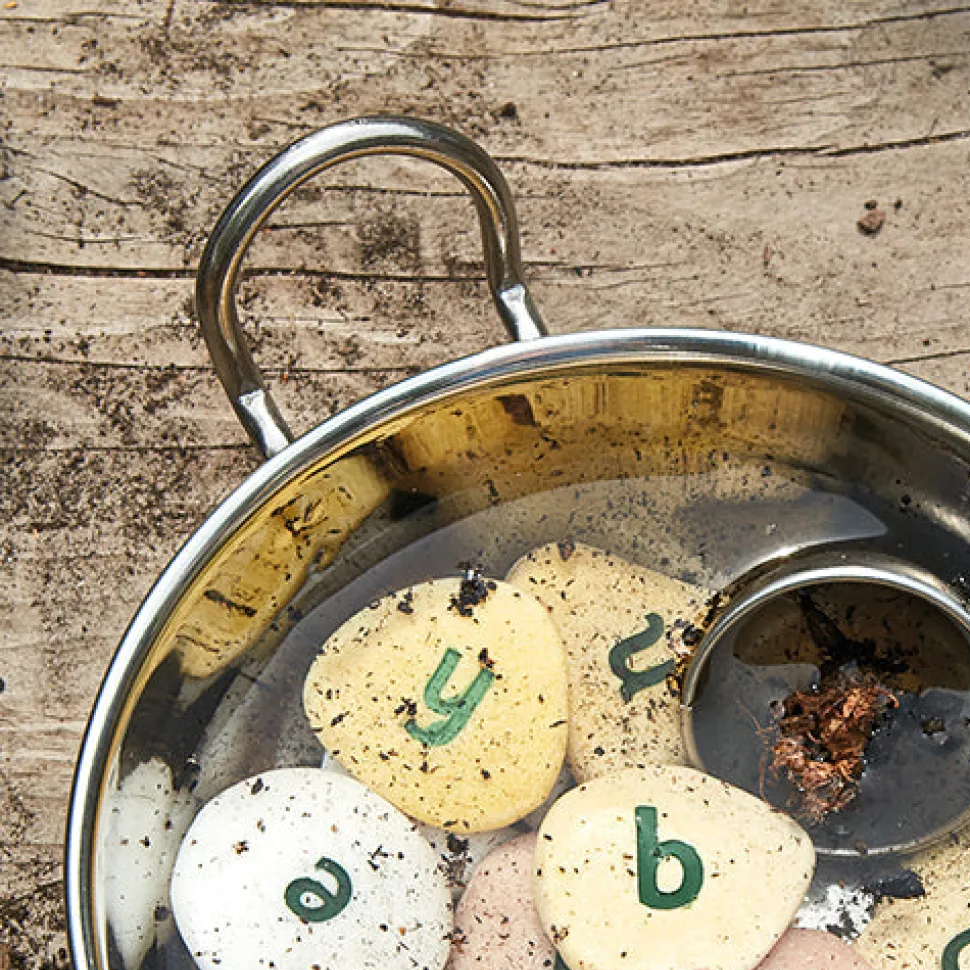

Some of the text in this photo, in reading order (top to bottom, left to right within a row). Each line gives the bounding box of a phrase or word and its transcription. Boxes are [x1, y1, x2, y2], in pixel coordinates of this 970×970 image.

[404, 648, 496, 746] y
[284, 857, 353, 923] e
[635, 805, 704, 910] b
